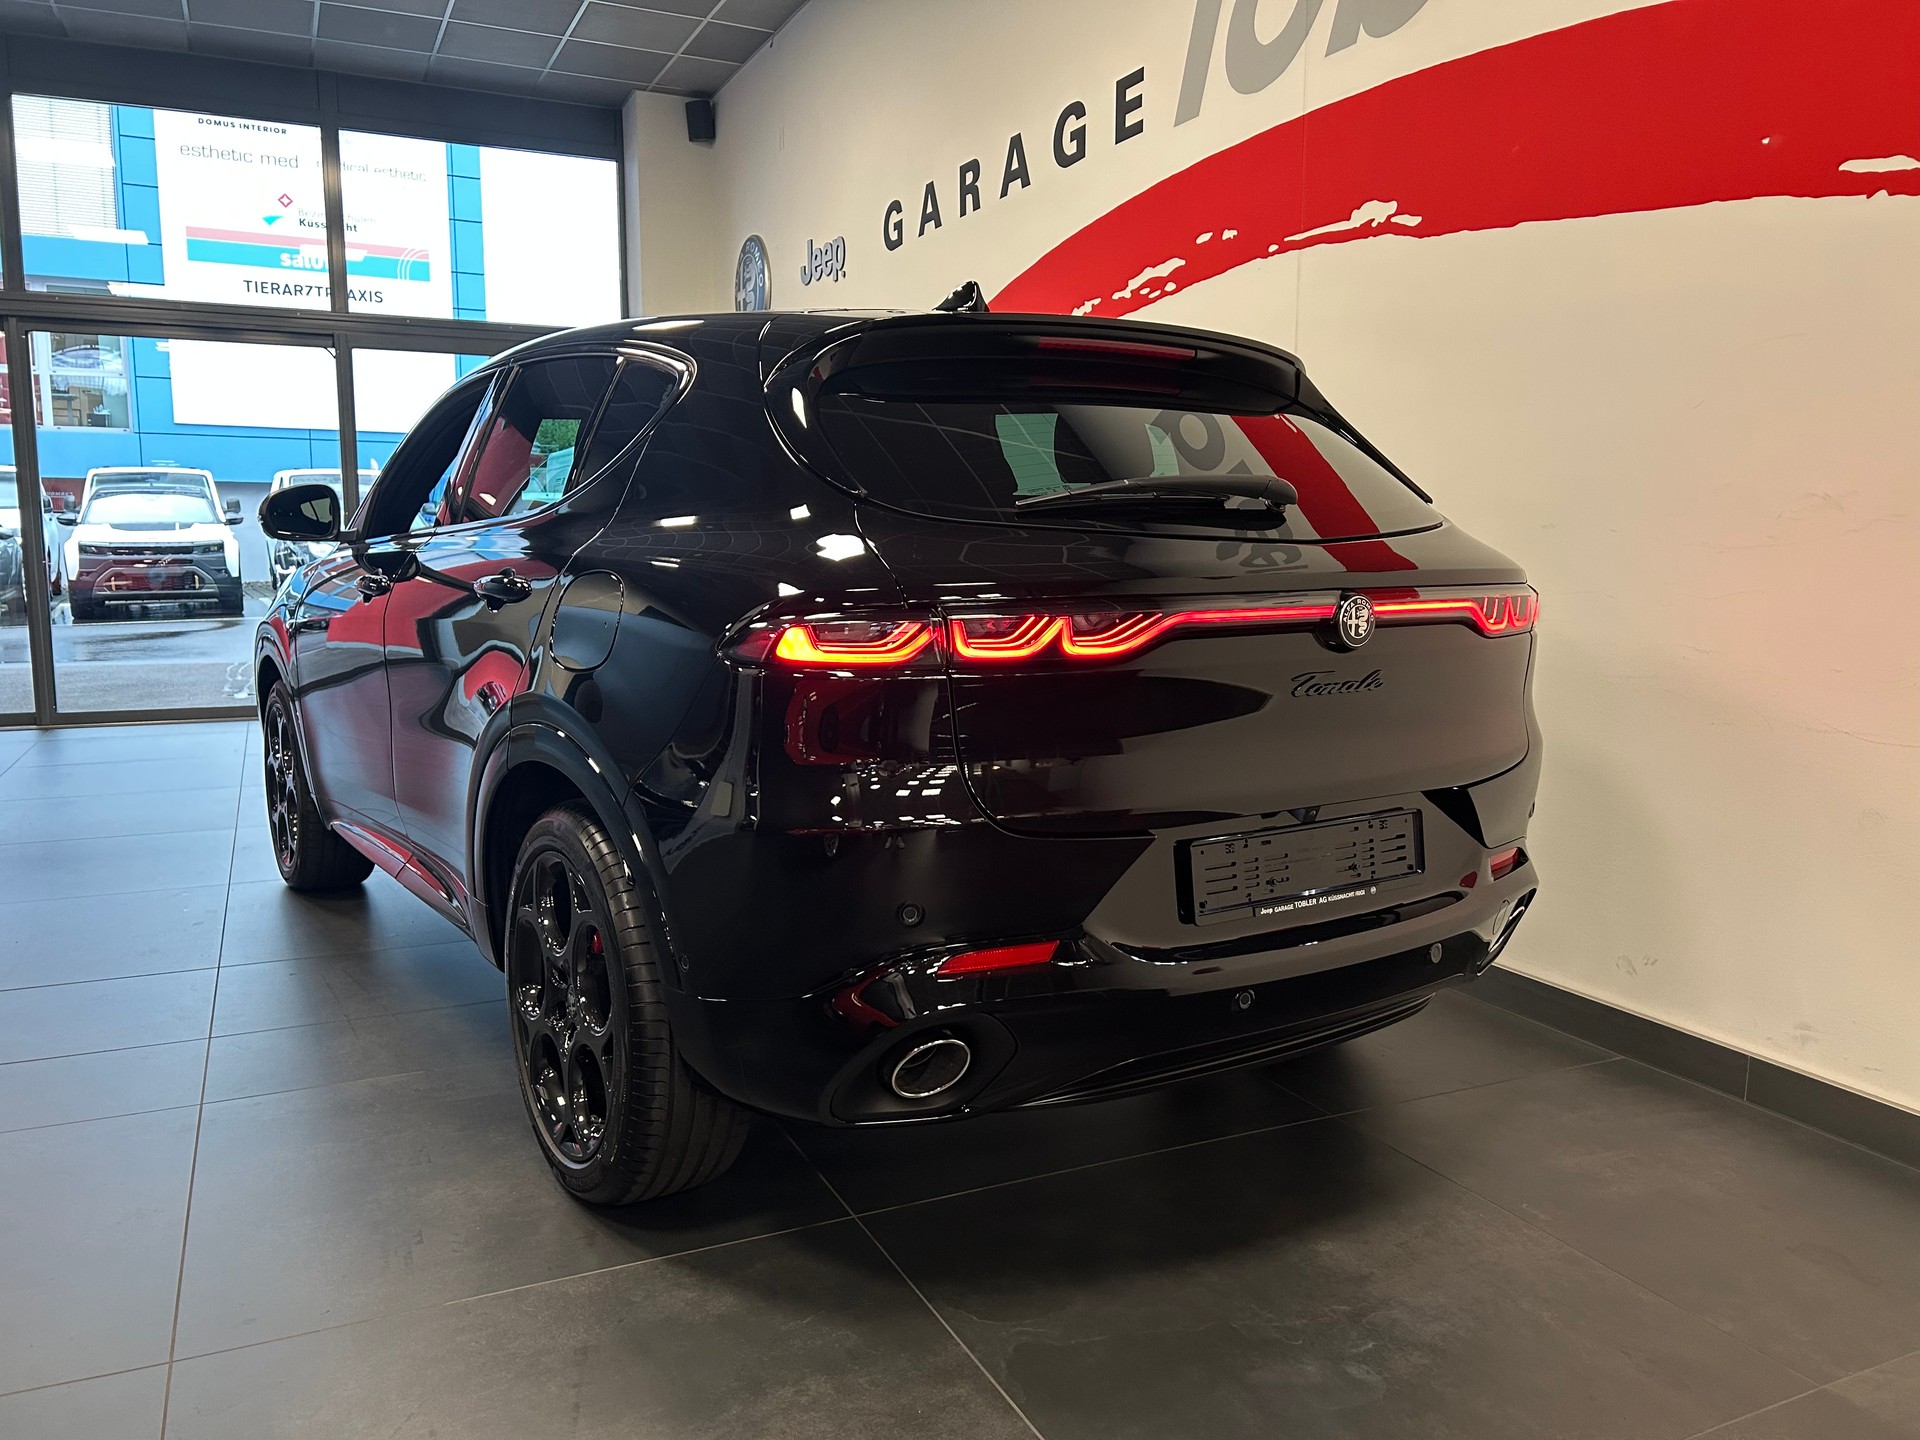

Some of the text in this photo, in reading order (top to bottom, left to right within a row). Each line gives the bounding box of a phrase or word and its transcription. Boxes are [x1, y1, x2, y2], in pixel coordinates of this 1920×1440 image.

[198, 117, 287, 135] DOMUS INTERIOR
[180, 144, 299, 169] esthetic med
[883, 66, 1145, 252] GARAGE
[298, 217, 358, 233] Küssht
[800, 236, 846, 286] Jeep
[1274, 903, 1294, 913] GARAGE
[1294, 898, 1317, 909] TOBLER
[1318, 896, 1328, 904] AG
